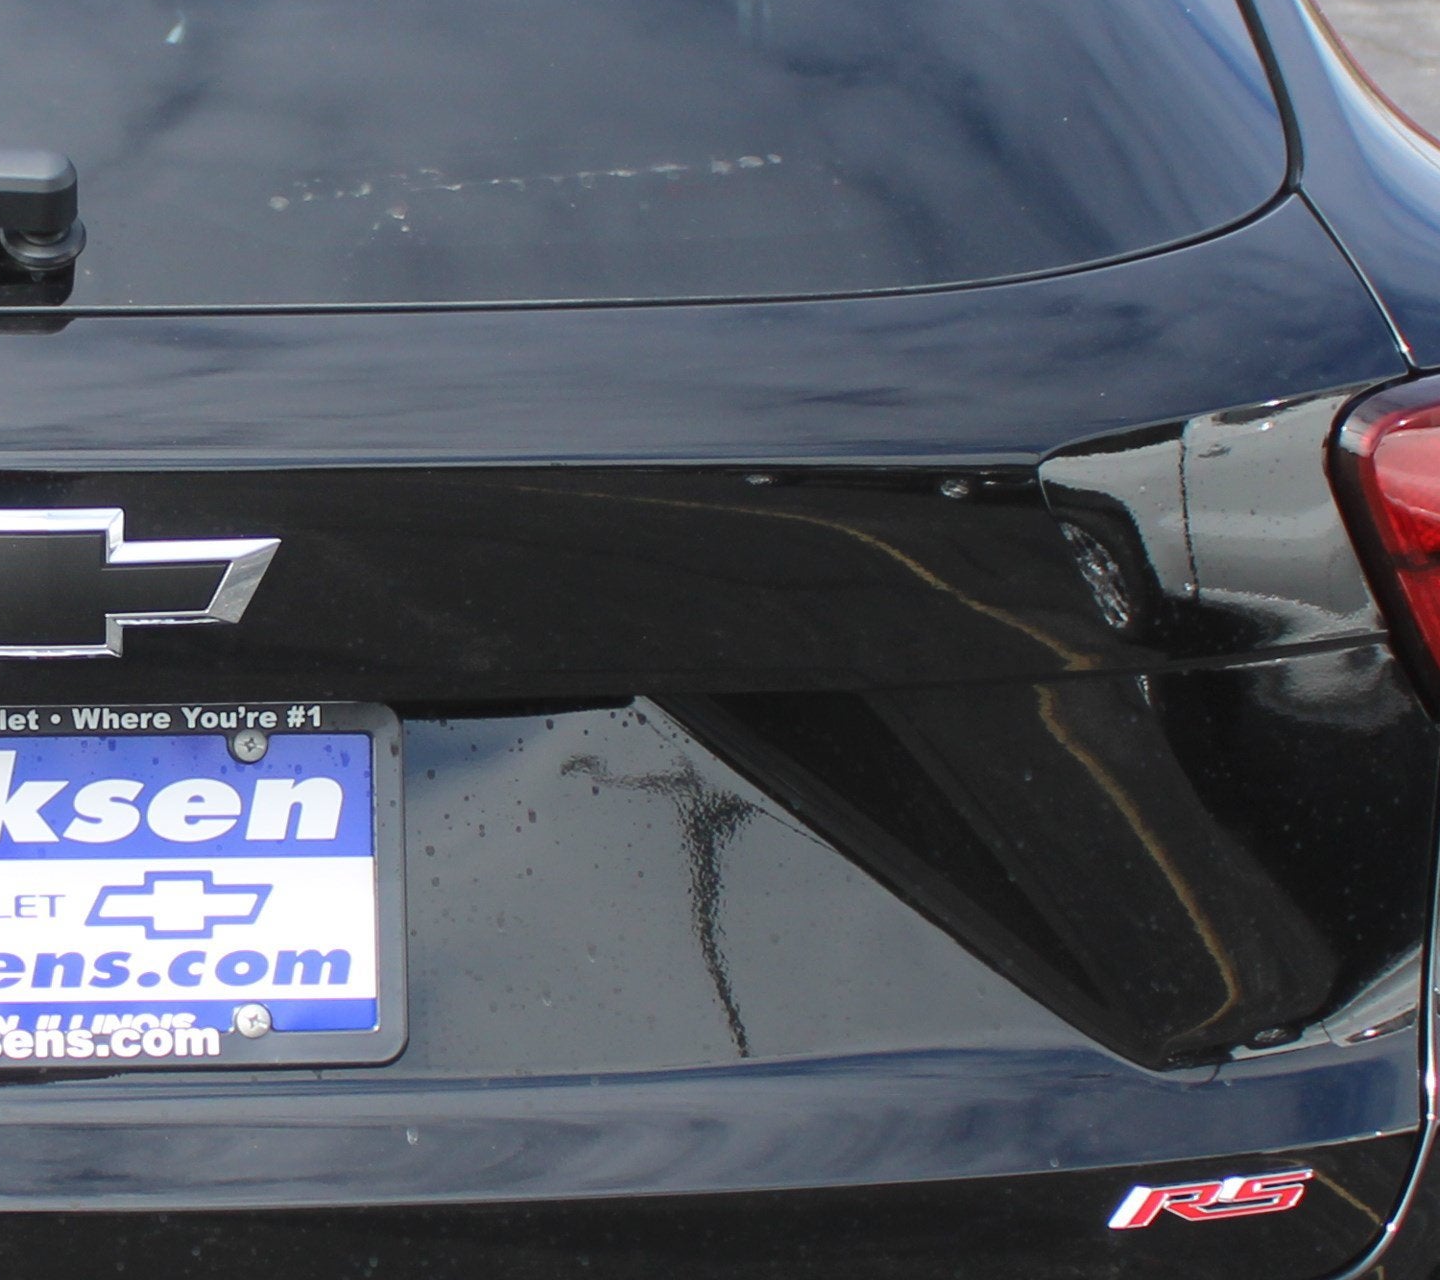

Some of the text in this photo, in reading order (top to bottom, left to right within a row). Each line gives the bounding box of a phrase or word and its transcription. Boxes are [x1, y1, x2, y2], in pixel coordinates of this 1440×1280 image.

[72, 707, 174, 731] Where
[180, 706, 278, 731] You're
[285, 705, 322, 728] #1
[1107, 1168, 1315, 1230] RS
